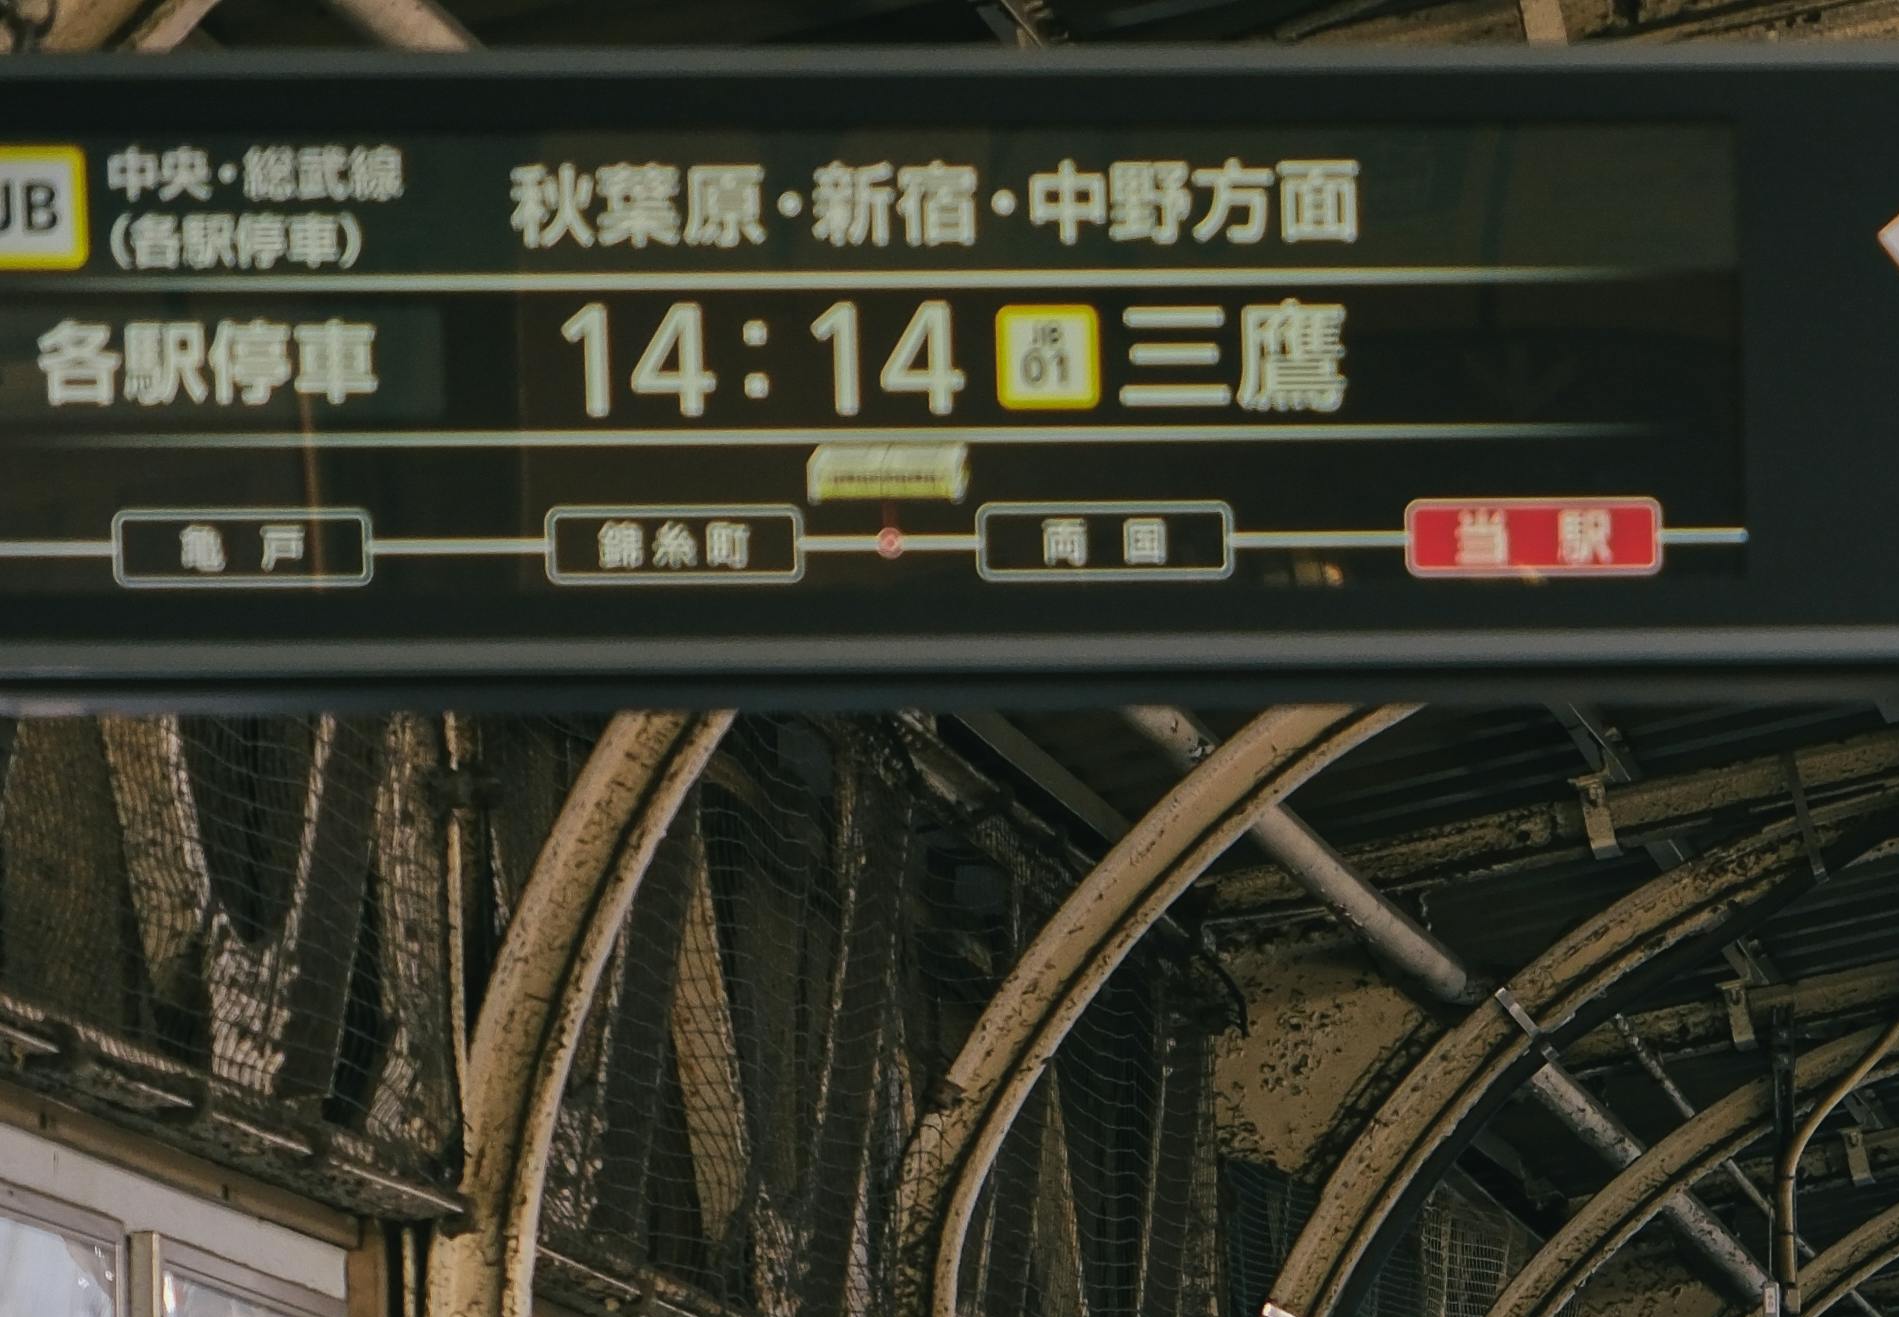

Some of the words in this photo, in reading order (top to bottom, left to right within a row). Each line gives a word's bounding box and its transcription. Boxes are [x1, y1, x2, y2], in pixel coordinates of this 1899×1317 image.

[509, 157, 1360, 249] 秋葉原・新宿・中野方面
[37, 318, 379, 407] 各駅停車
[560, 300, 967, 417] 14:14
[1019, 347, 1069, 389] 01
[1119, 298, 1348, 412] 三鷹
[1041, 517, 1167, 567] 両国
[1454, 507, 1613, 565] 当駅
